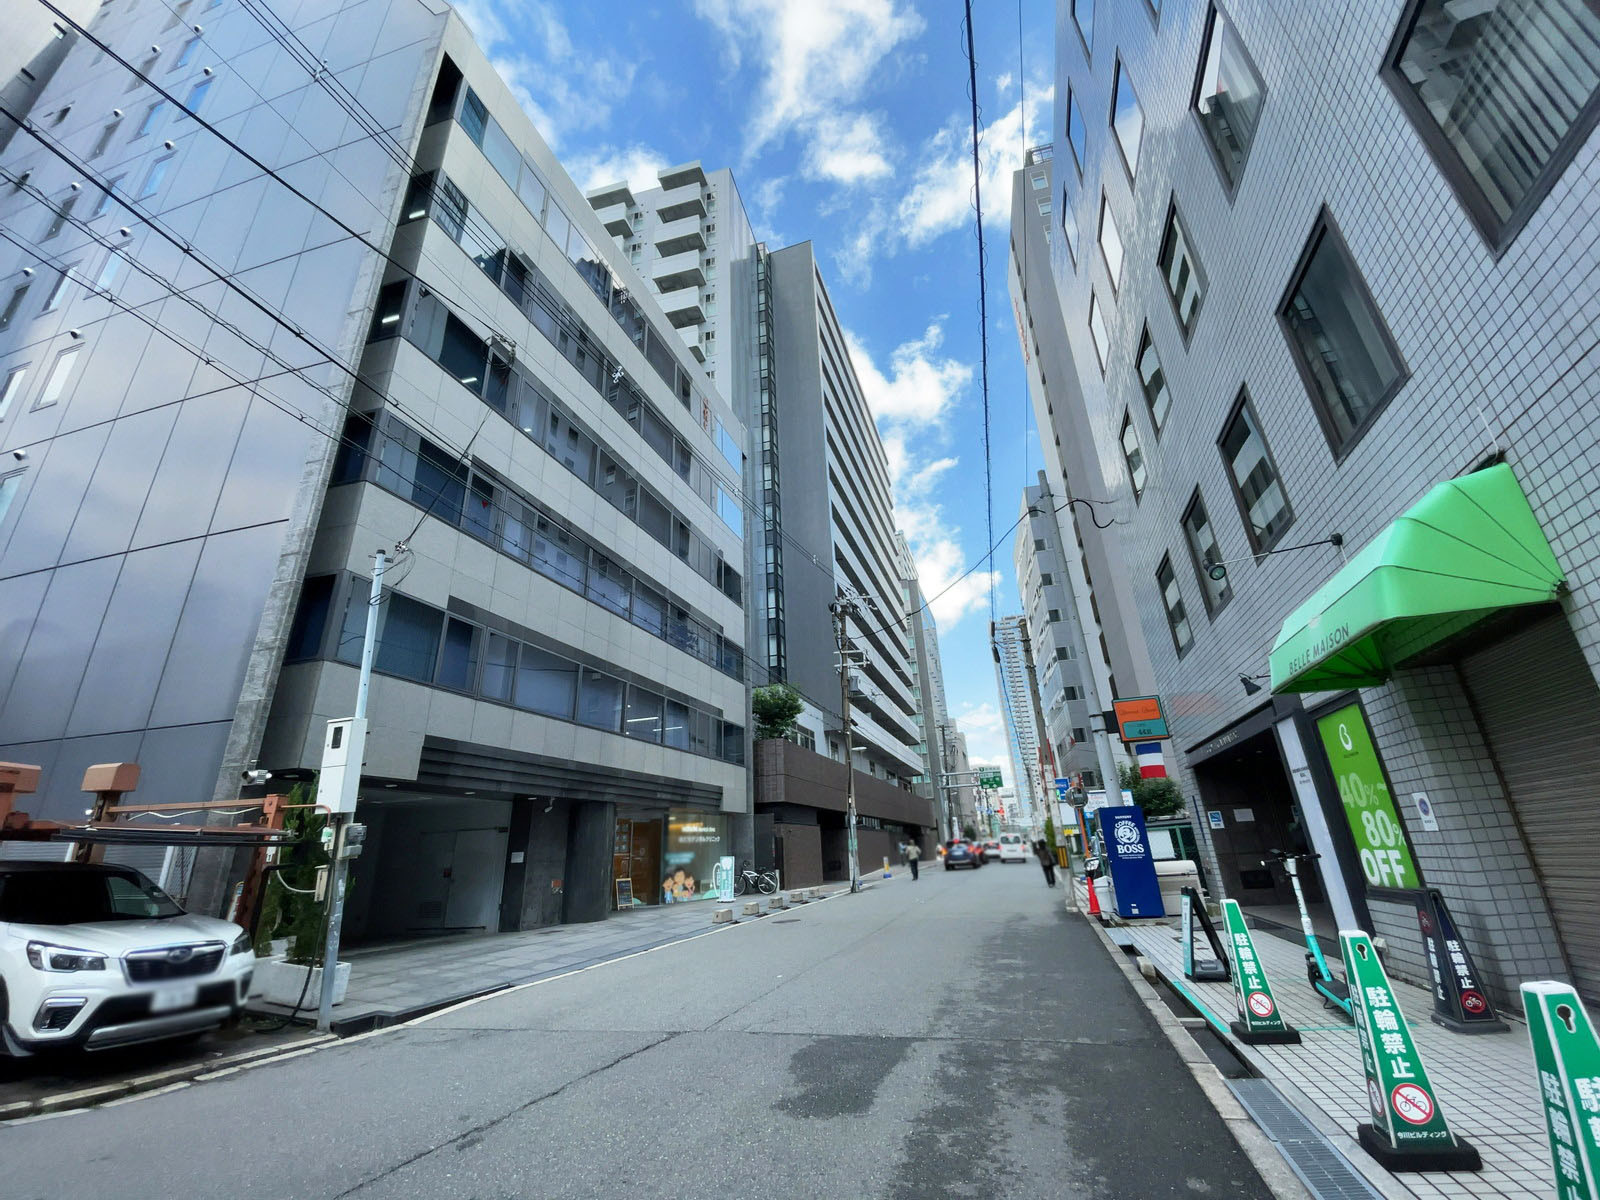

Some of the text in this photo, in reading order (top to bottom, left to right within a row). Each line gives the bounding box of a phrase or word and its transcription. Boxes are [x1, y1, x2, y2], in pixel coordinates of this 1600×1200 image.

[1288, 622, 1350, 675] BELLE MAISON
[1114, 820, 1136, 828] COFFEE
[1361, 809, 1407, 848] 80%
[1116, 843, 1145, 854] BOSS
[1360, 848, 1406, 888] OFF
[1233, 932, 1263, 990] 駐輪禁止
[1445, 939, 1475, 989] 駐輪禁止
[1365, 986, 1415, 1078] 駐輪禁止
